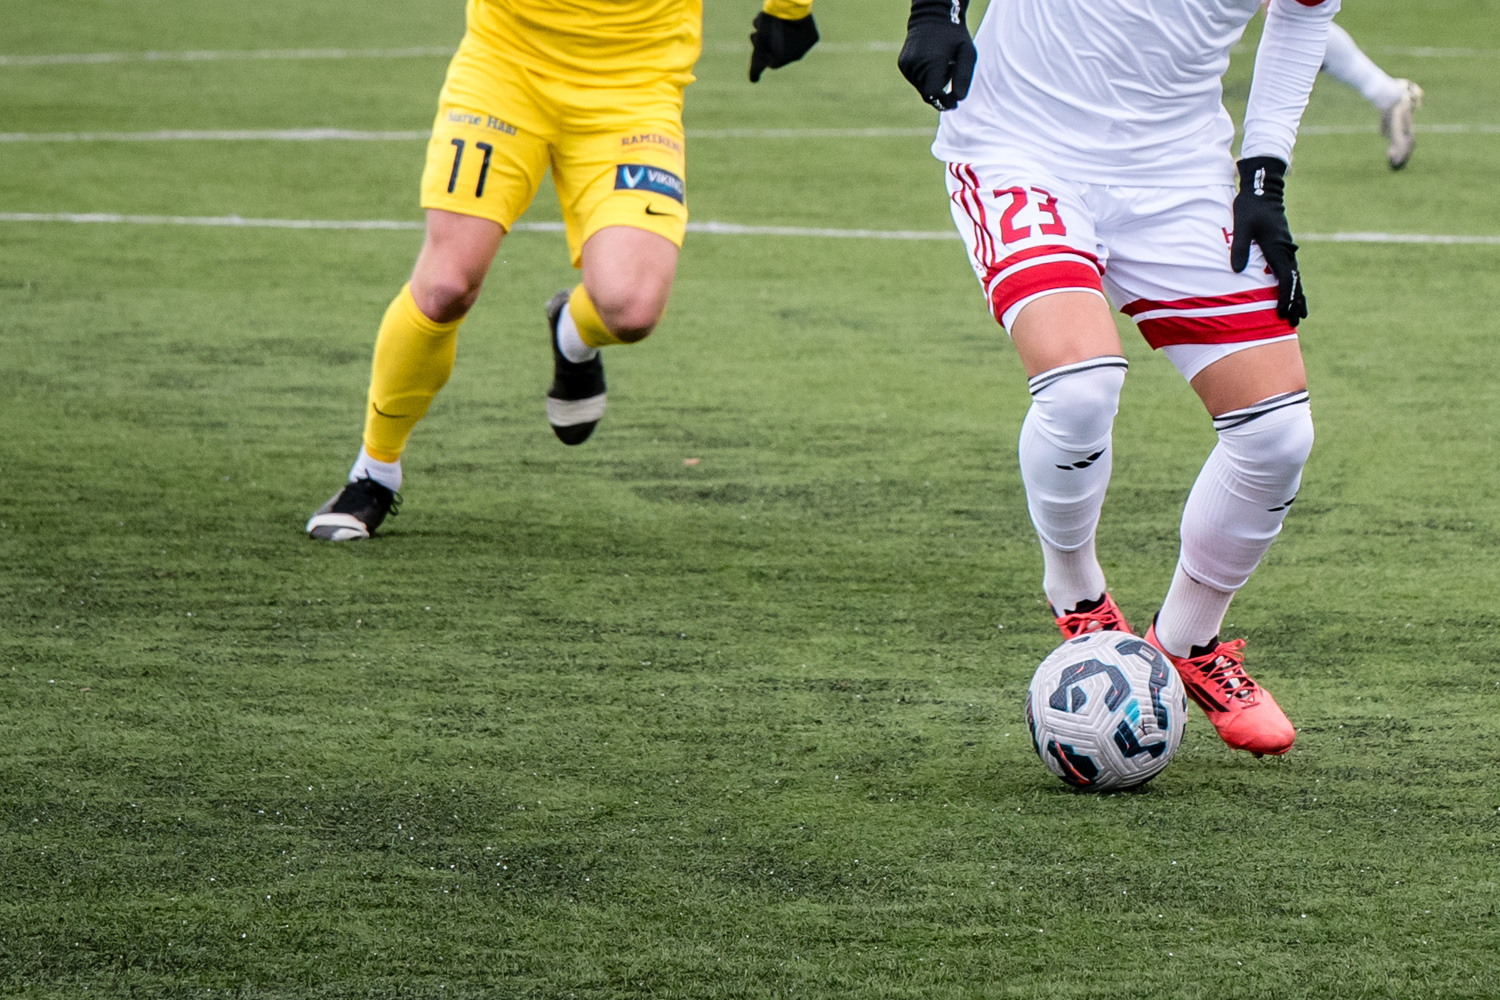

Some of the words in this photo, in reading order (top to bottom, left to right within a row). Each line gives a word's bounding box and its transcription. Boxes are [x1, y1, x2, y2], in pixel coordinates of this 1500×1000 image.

[447, 138, 493, 198] 11
[621, 134, 681, 151] RAMIREN
[993, 186, 1066, 246] 23
